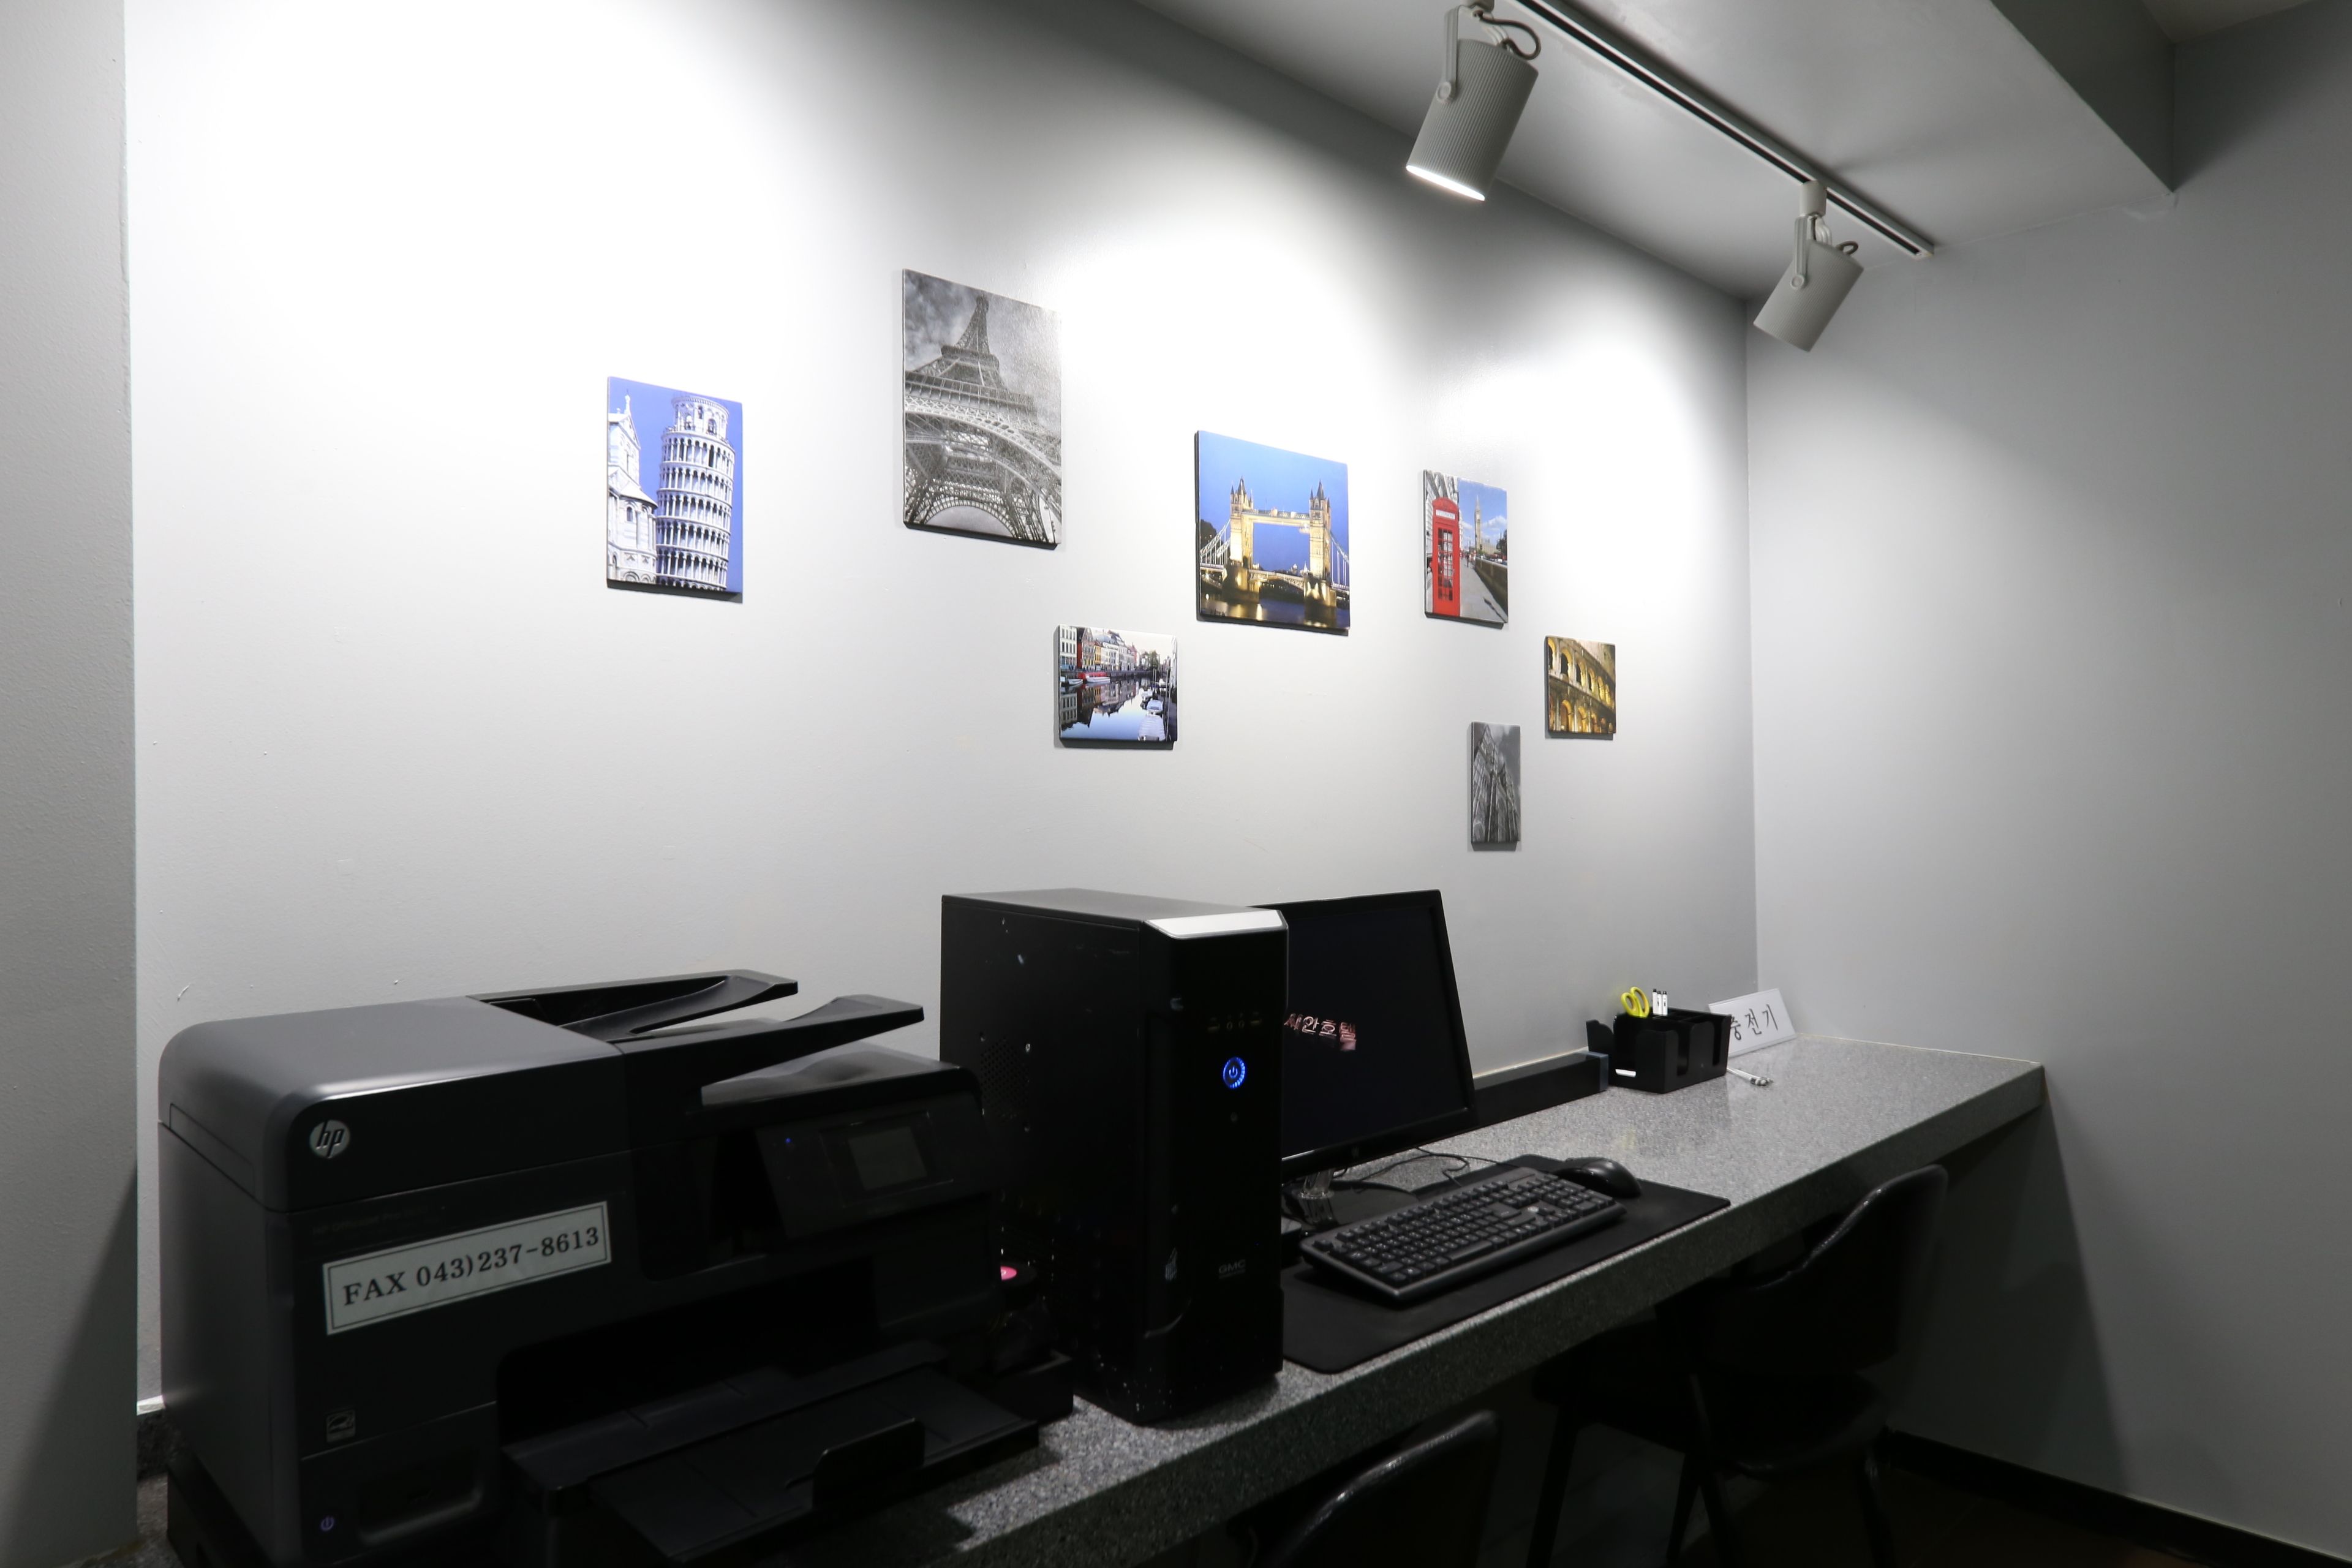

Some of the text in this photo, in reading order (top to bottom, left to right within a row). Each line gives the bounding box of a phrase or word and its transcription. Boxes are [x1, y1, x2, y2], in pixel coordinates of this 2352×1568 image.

[315, 1120, 345, 1158] hp
[343, 1227, 599, 1306] FAX 043)237-8613
